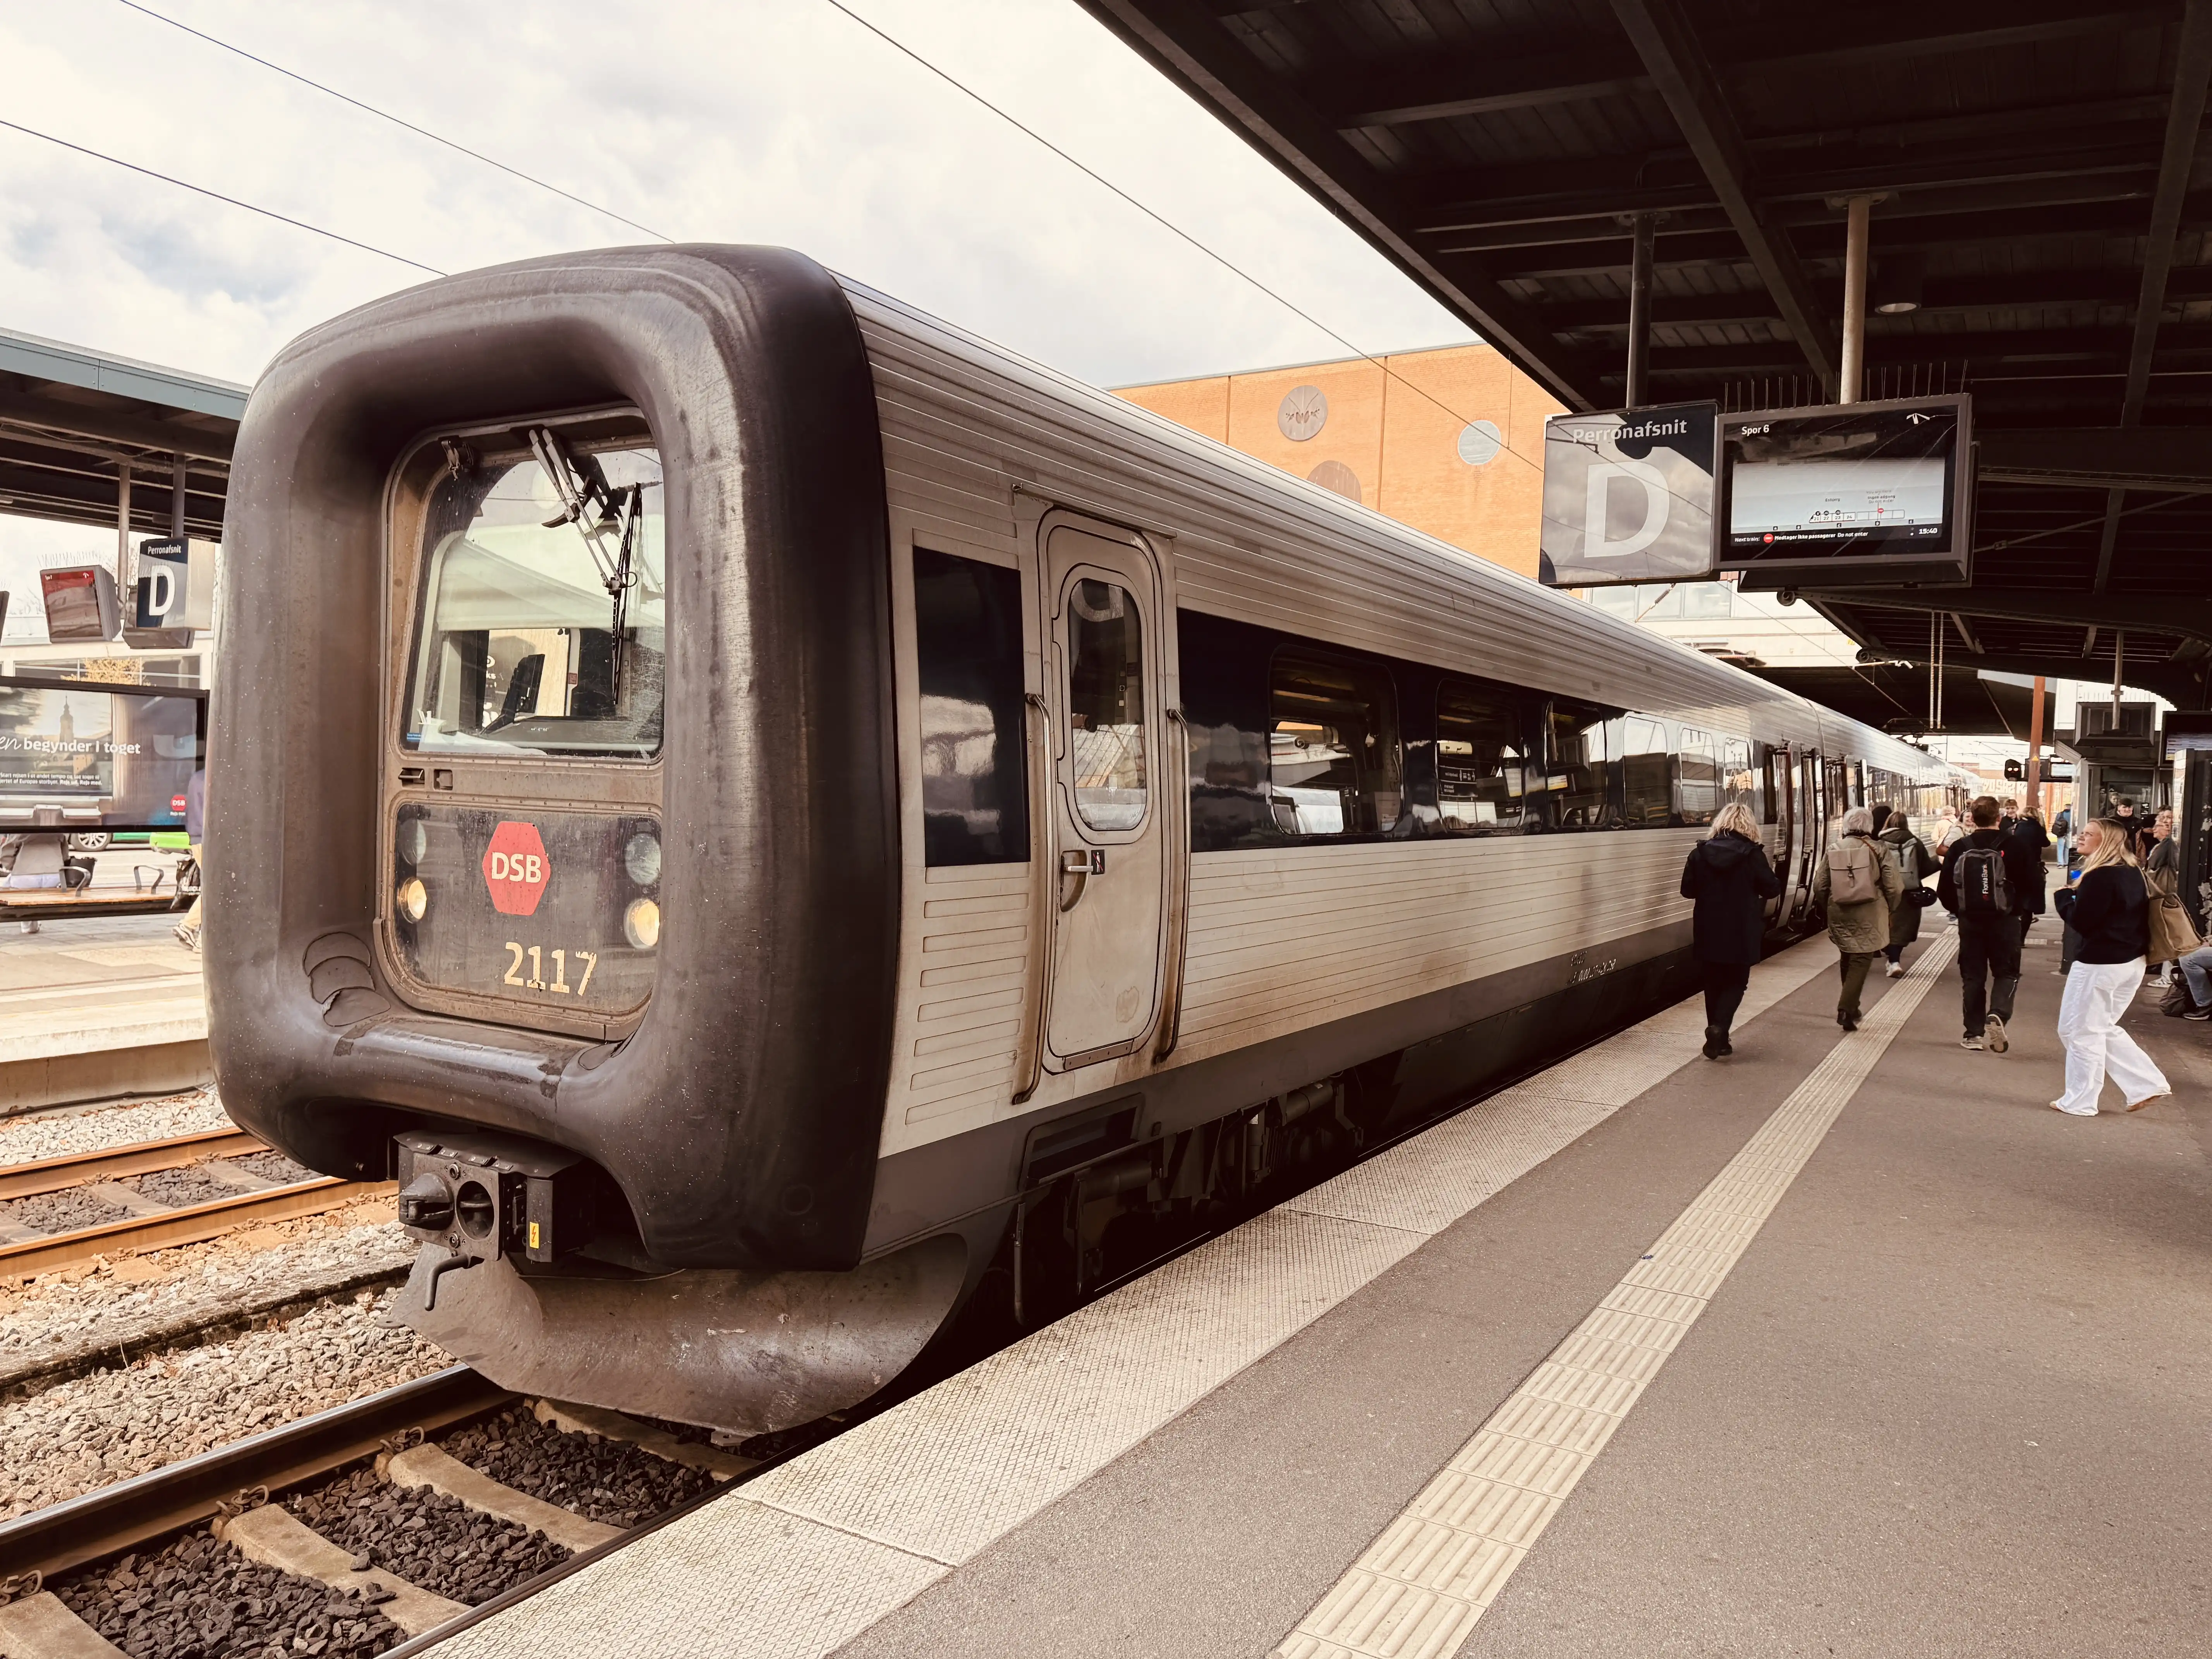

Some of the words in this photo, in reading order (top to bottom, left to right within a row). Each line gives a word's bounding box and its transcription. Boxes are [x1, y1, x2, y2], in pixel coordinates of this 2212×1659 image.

[1573, 419, 1687, 443] Perronafsnit
[1741, 426, 1761, 436] Spor
[1764, 424, 1769, 433] 6
[1584, 462, 1669, 558] D
[148, 544, 181, 555] Perronafsnit
[149, 565, 175, 616] D
[24, 737, 92, 753] begynder
[96, 740, 100, 752] i
[104, 743, 141, 756] toget
[491, 852, 541, 883] DSB
[504, 942, 597, 996] 2117
